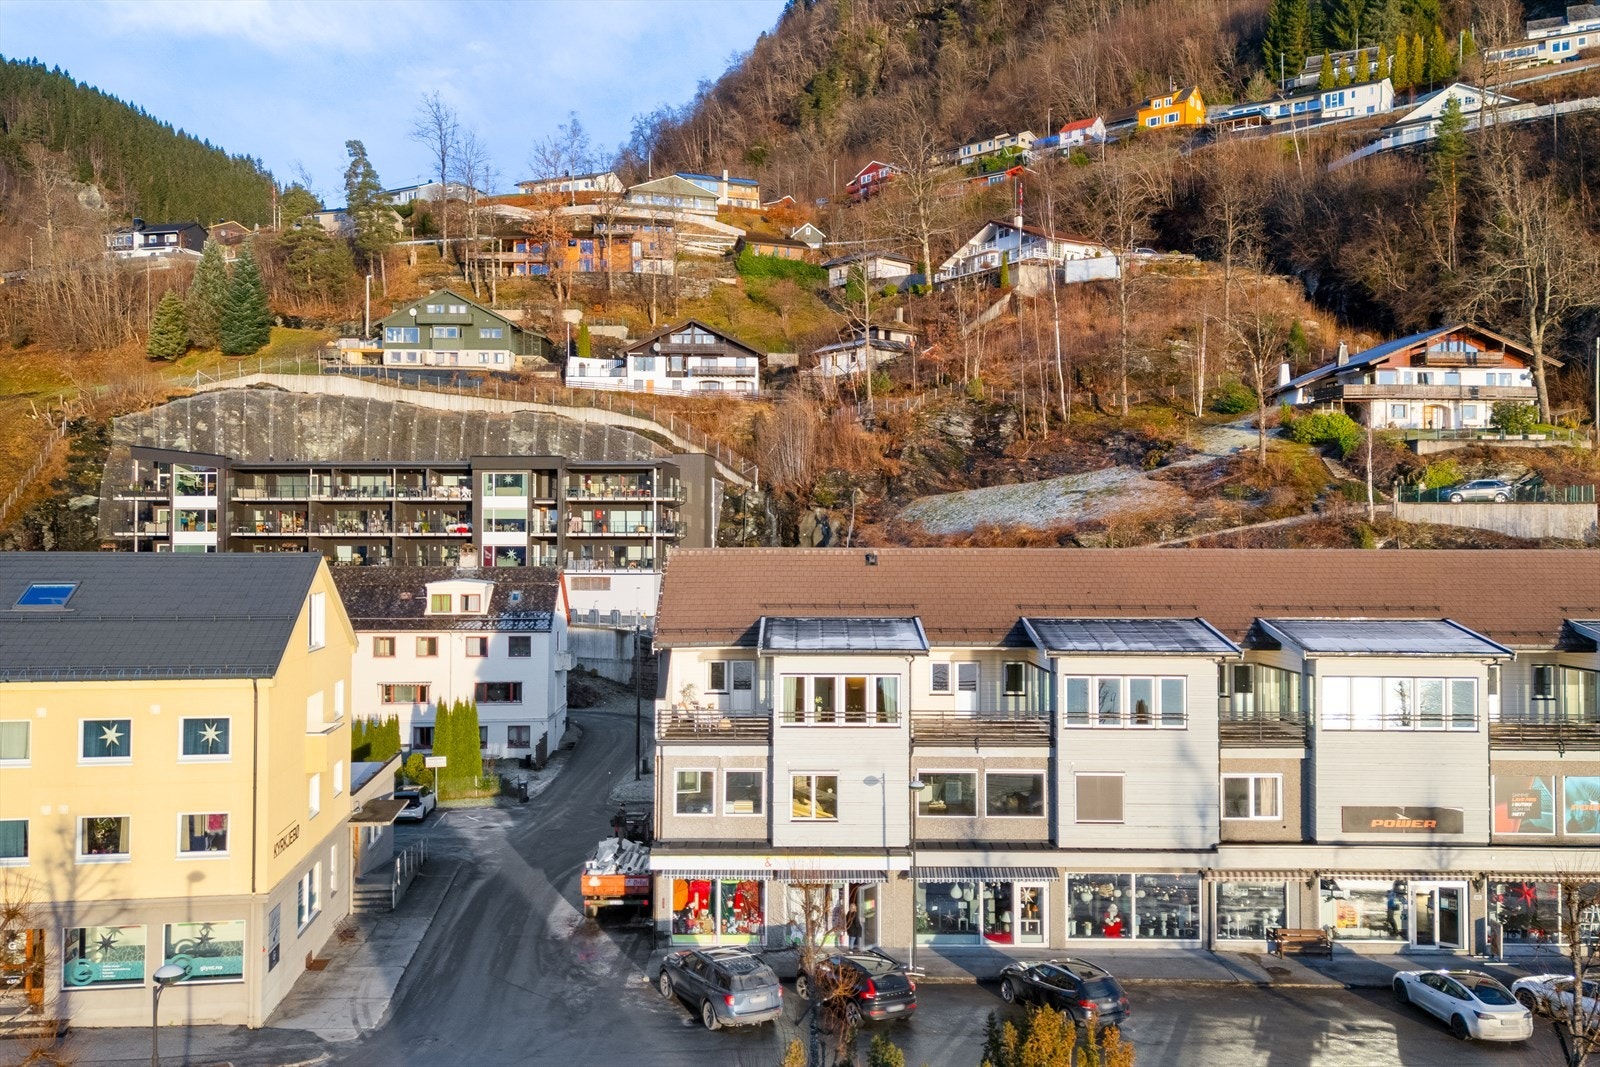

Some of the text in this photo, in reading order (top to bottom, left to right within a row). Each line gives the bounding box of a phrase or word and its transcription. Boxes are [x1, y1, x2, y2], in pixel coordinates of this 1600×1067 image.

[1371, 820, 1437, 828] POWER
[273, 824, 300, 859] KYRKJEBØ
[765, 857, 771, 867] &
